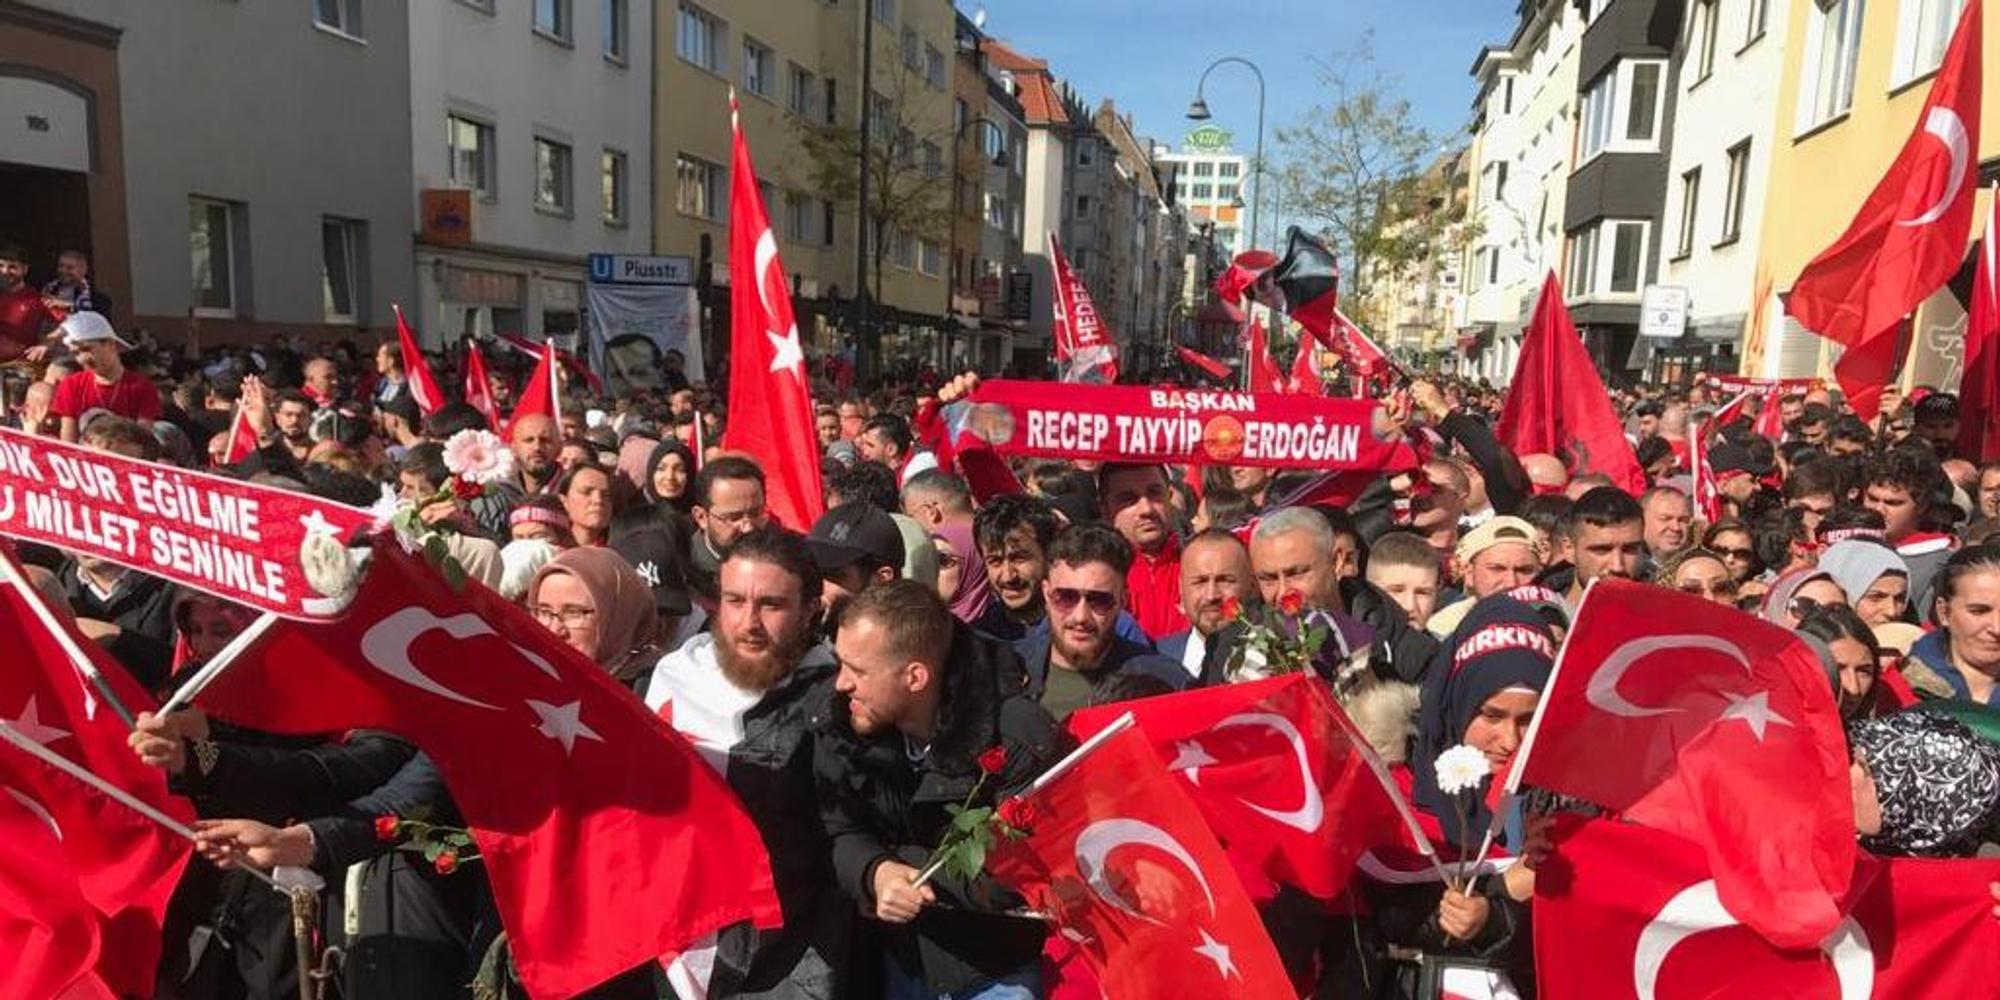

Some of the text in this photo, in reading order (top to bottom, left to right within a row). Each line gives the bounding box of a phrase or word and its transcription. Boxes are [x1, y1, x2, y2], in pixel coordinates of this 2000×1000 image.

[593, 256, 610, 277] U
[1151, 391, 1256, 414] BAŞKAN
[1027, 409, 1361, 461] RECEP TAYYİP ERDOĞAN
[47, 451, 123, 505] DUR
[129, 468, 261, 543] EĞİLME
[25, 487, 140, 557] MİLLET
[149, 525, 287, 604] SENİNLE
